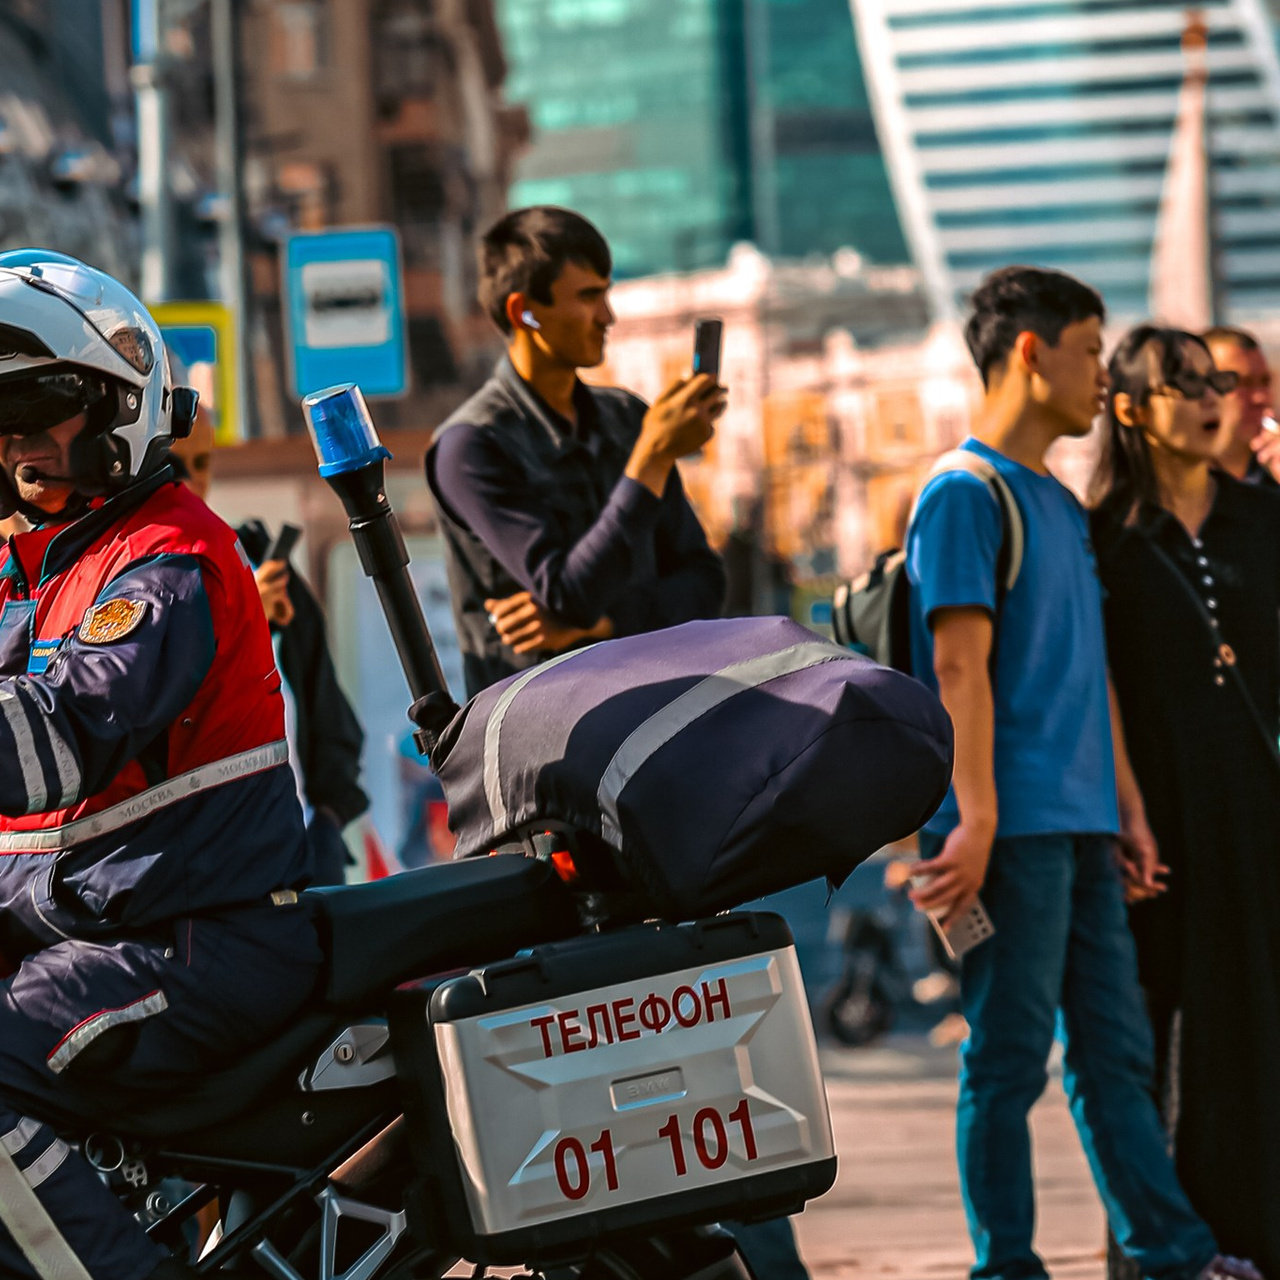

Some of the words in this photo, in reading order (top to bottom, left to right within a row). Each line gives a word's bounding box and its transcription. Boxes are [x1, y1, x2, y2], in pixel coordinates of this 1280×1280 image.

[120, 789, 174, 819] МОСКВА
[531, 978, 731, 1058] ТЕЛЕФОН
[554, 1129, 618, 1200] 01
[658, 1098, 758, 1176] 101
